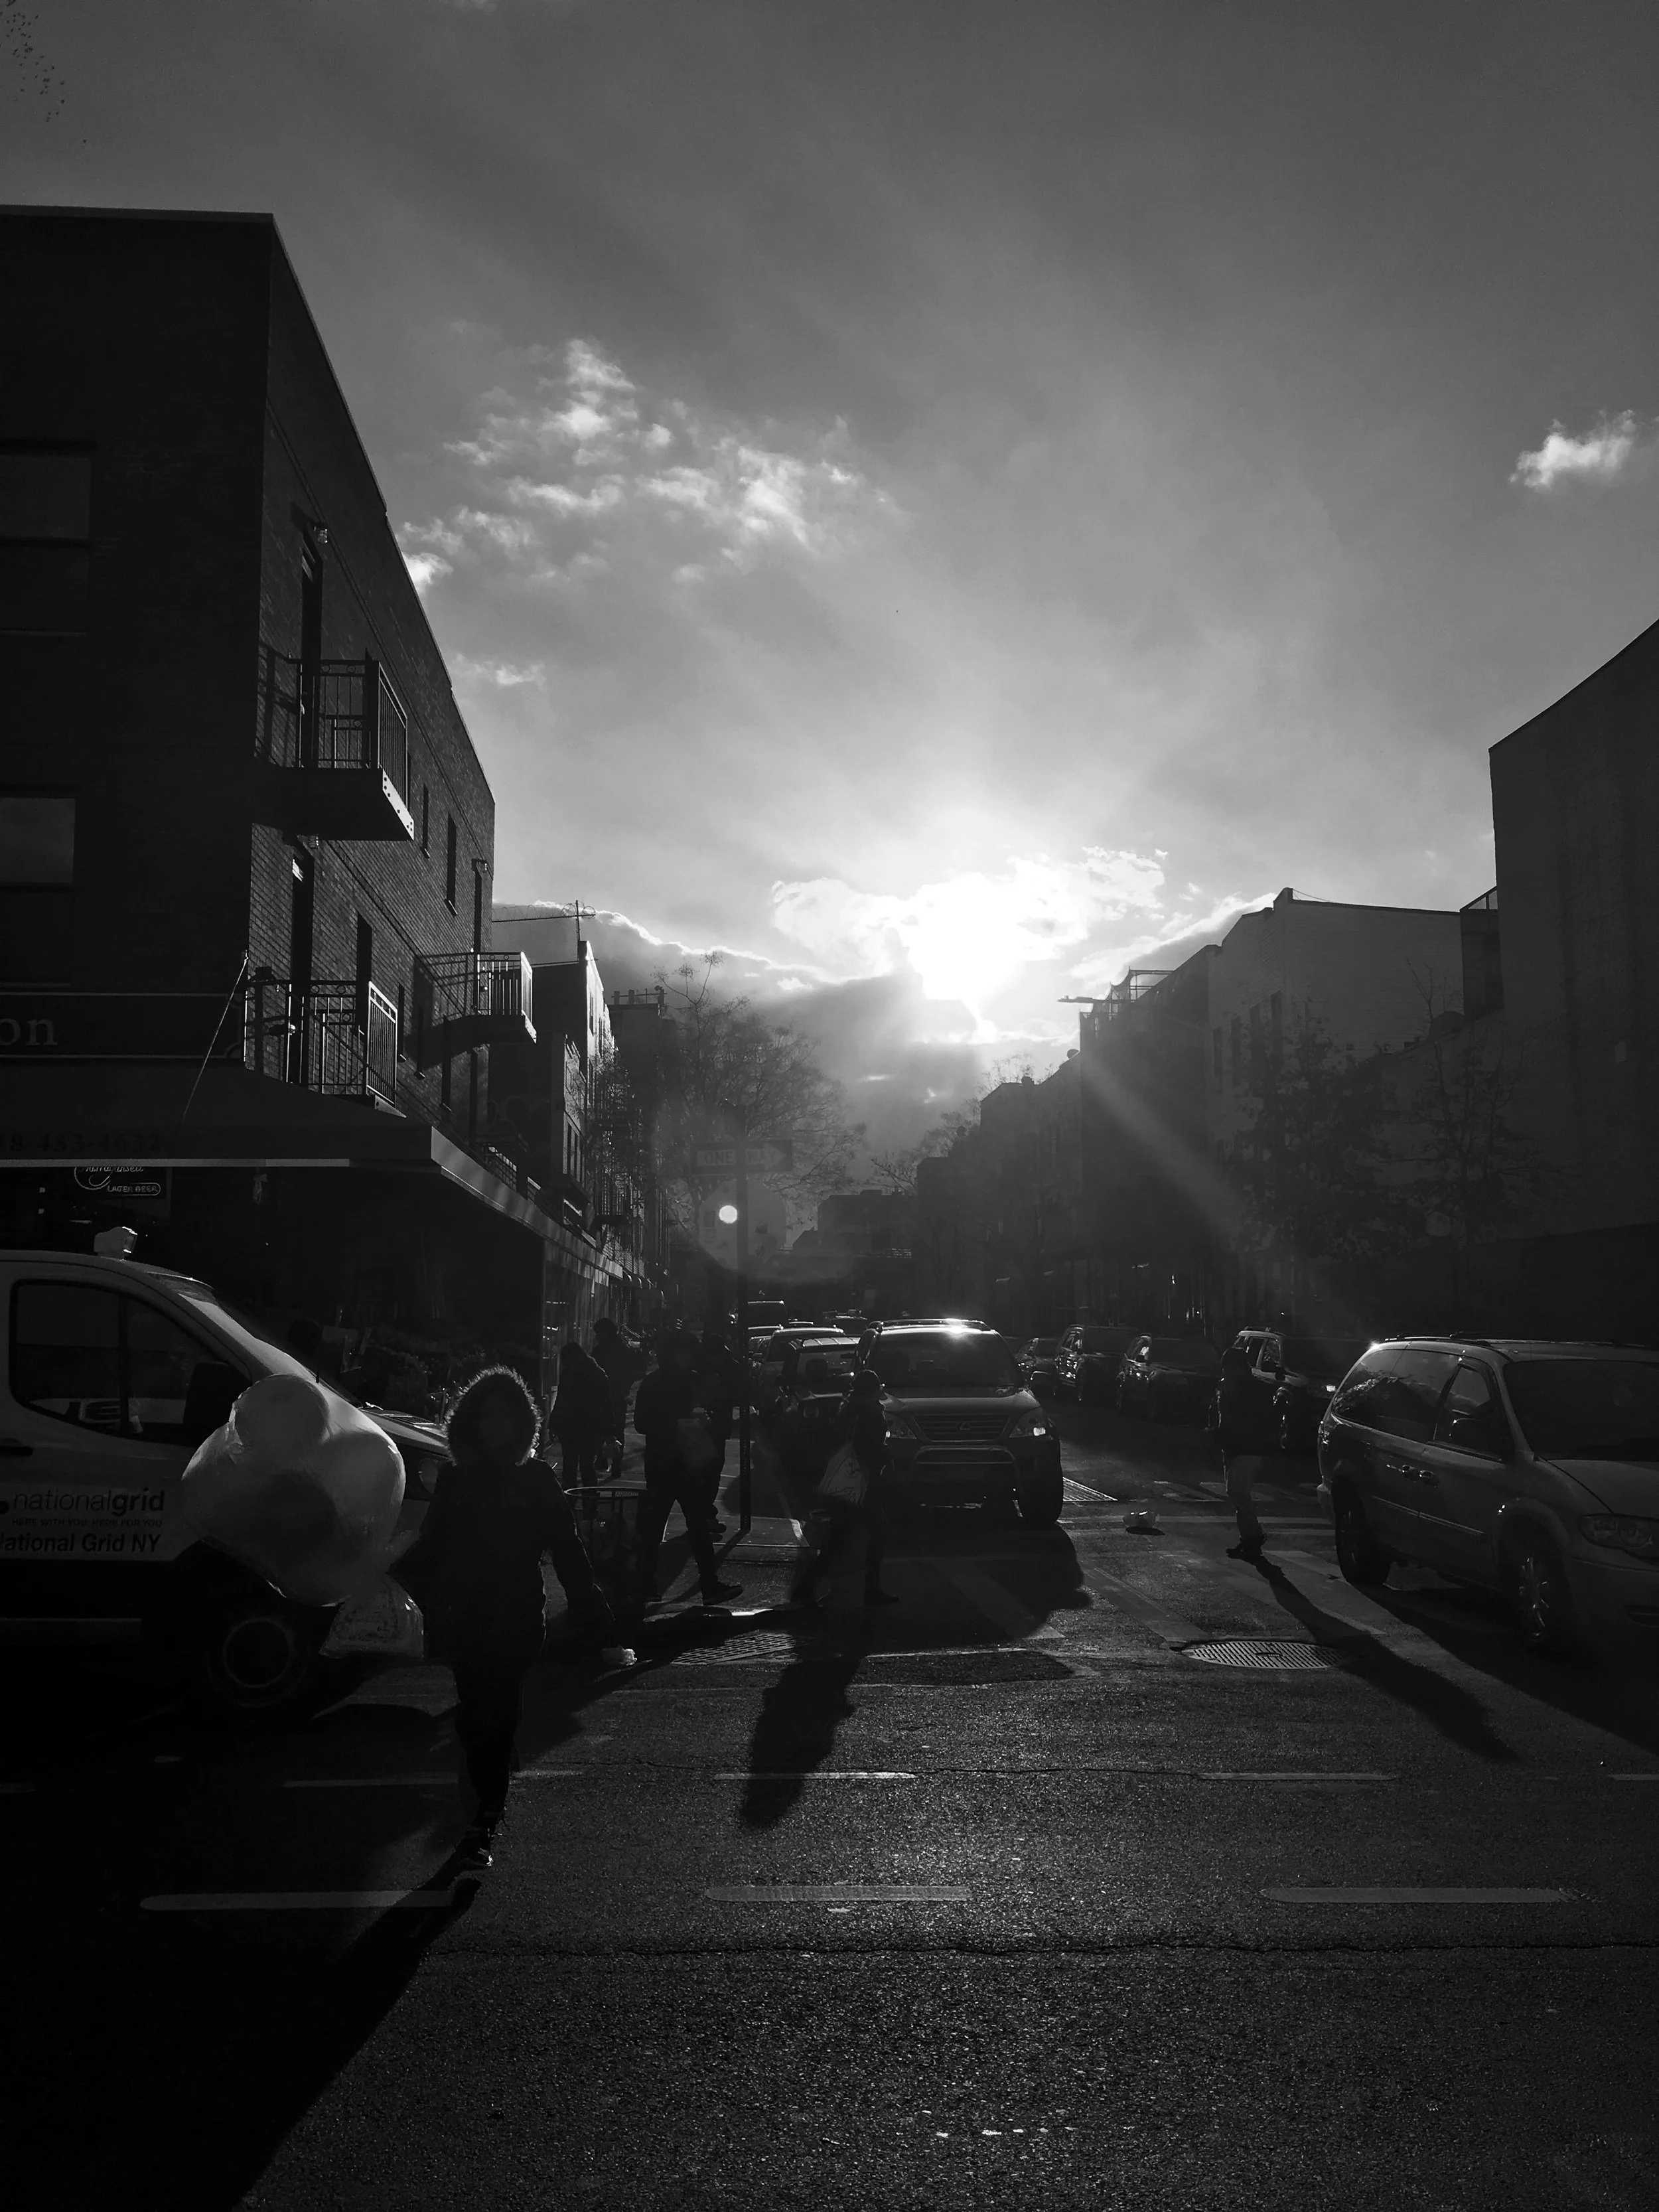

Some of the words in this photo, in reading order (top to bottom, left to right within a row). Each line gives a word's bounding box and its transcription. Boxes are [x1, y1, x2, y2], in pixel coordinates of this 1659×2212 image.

[0, 1018, 58, 1046] on
[705, 1151, 734, 1164] ONE
[746, 1150, 775, 1163] WAY
[13, 1487, 165, 1517] nationalgrid
[12, 1518, 37, 1527] HERE
[40, 1518, 65, 1527] WITH
[92, 1518, 117, 1527] HERE
[120, 1518, 140, 1528] FOR
[0, 1532, 75, 1552] ational
[82, 1532, 125, 1552] Grid
[131, 1533, 162, 1552] NY
